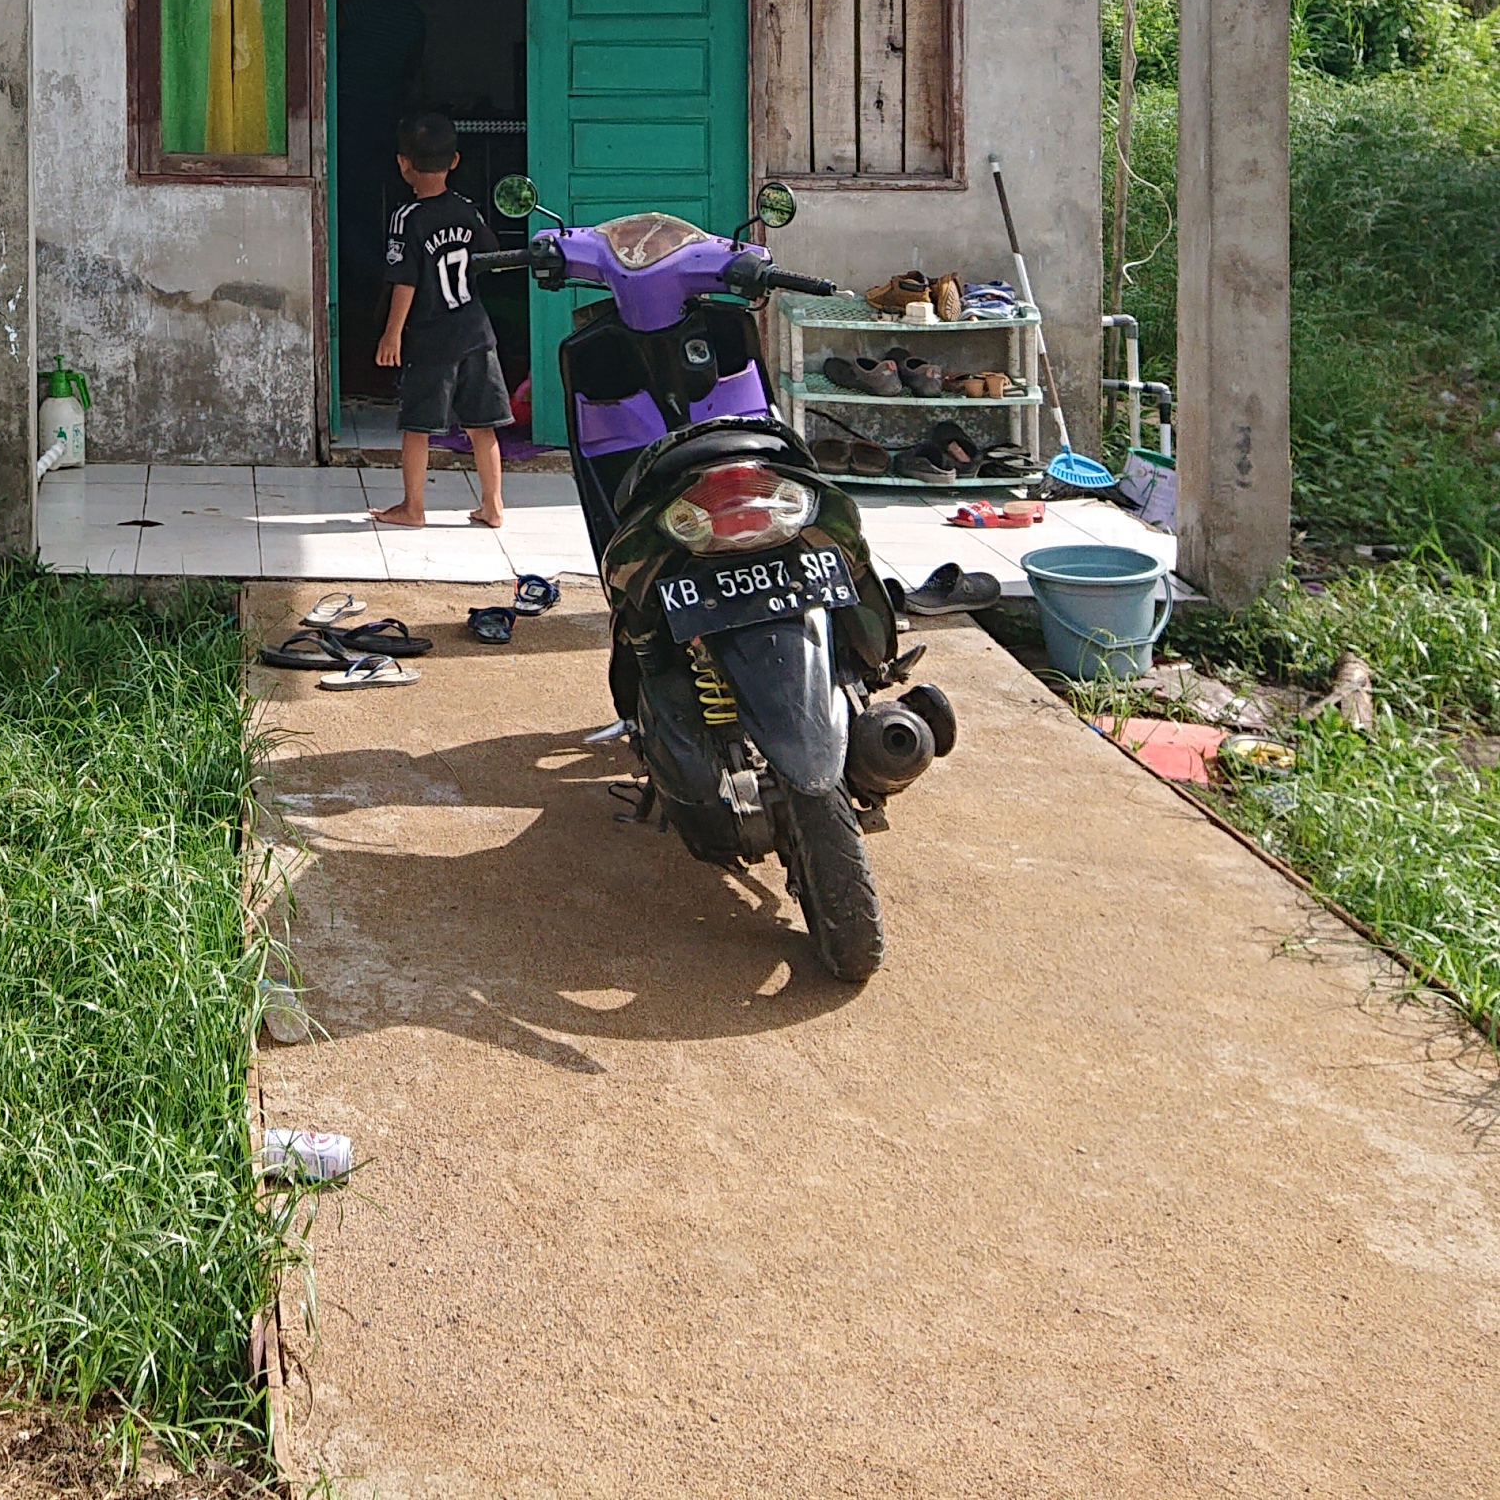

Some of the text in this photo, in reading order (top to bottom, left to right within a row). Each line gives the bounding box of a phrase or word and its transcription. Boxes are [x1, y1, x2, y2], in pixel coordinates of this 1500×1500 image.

[424, 226, 472, 255] HAZARD
[436, 247, 472, 310] 17
[660, 579, 700, 611] KB
[716, 560, 785, 598] 5587
